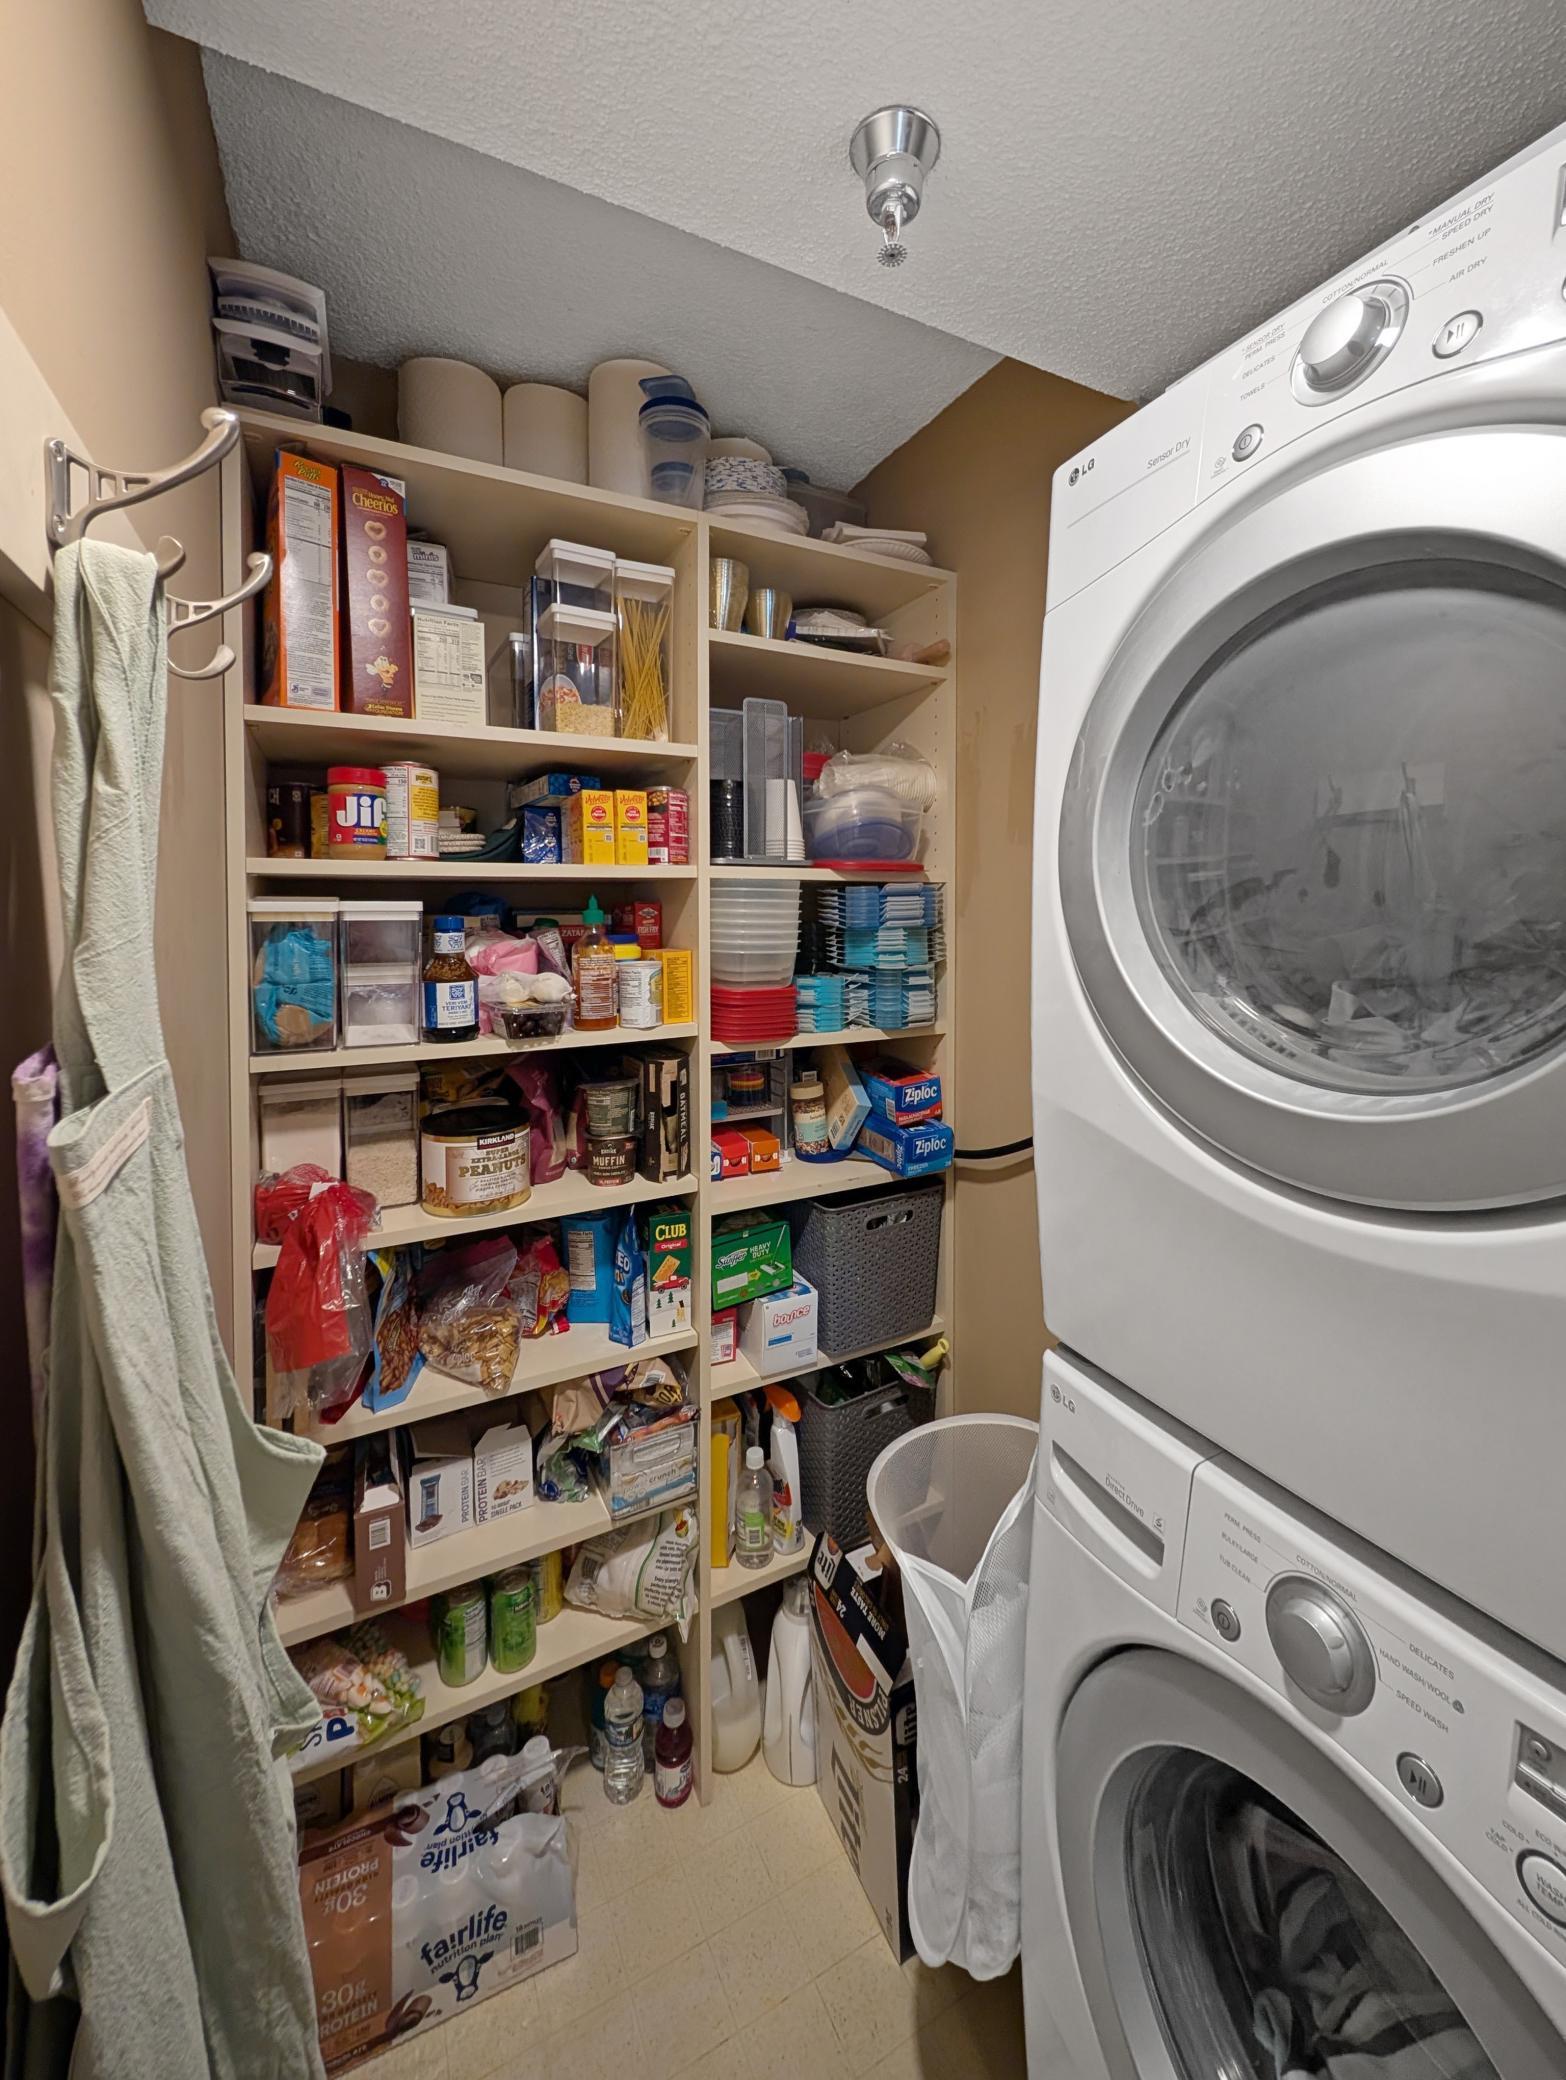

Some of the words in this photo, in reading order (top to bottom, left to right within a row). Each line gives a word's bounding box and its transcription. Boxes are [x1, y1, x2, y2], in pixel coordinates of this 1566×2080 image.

[1474, 192, 1496, 209] DRY
[1441, 218, 1472, 240] SPEED
[1473, 204, 1494, 222] DRY
[1433, 237, 1475, 266] FRESHEN
[1477, 227, 1492, 241] UP
[1449, 268, 1465, 282] AIR
[1466, 256, 1488, 273] DRY
[1242, 356, 1276, 379] DELICATES
[1240, 383, 1265, 400] TOWELS
[1147, 448, 1174, 470] Sensor
[1175, 437, 1191, 453] Dry
[1081, 458, 1095, 477] LG
[352, 492, 399, 515] Cheerios
[904, 1086, 938, 1105] Ziploc
[680, 1091, 688, 1142] OATMEAL
[479, 1133, 516, 1146] KIRKLAND
[485, 1146, 509, 1156] SUPER
[915, 1138, 947, 1157] Ziploc
[458, 1153, 527, 1178] PEANUTS
[592, 1155, 626, 1166] MUFFIN
[655, 1223, 687, 1241] CLUB
[660, 1241, 682, 1250] Original
[715, 1247, 749, 1270] Swiffer
[749, 1241, 772, 1254] HEAVY
[752, 1248, 770, 1259] DUTY
[772, 1304, 811, 1328] bounce
[1062, 1396, 1076, 1415] LG
[476, 1455, 487, 1478] BAR
[460, 1484, 470, 1524] PROTEIN
[477, 1477, 488, 1523] PROTEIN
[1105, 1477, 1126, 1500] Direct
[1125, 1496, 1145, 1518] Drive
[1219, 1554, 1231, 1565] TUB
[1231, 1562, 1251, 1584] CLEAN
[1296, 1554, 1357, 1602] COTTON/NORMAL
[835, 1599, 847, 1618] 24
[850, 1586, 869, 1617] TASTE
[866, 1608, 886, 1641] MORE
[1409, 1643, 1455, 1680] DELICATES
[1380, 1647, 1401, 1668] HAND
[1401, 1663, 1451, 1705] WASH/WOOL
[848, 1688, 888, 1729] PILSNER
[1396, 1689, 1422, 1713] SPEED
[1423, 1709, 1449, 1733] WASH
[898, 1767, 909, 1784] 24
[420, 1828, 501, 1874] fairlife
[314, 1857, 380, 1896] PROTEIN
[323, 1883, 369, 1918] 30g
[420, 1904, 508, 1967] fairlife
[430, 1941, 478, 1975] nutrition
[479, 1932, 505, 1947] plan
[320, 1999, 378, 2040] ROTEIN
